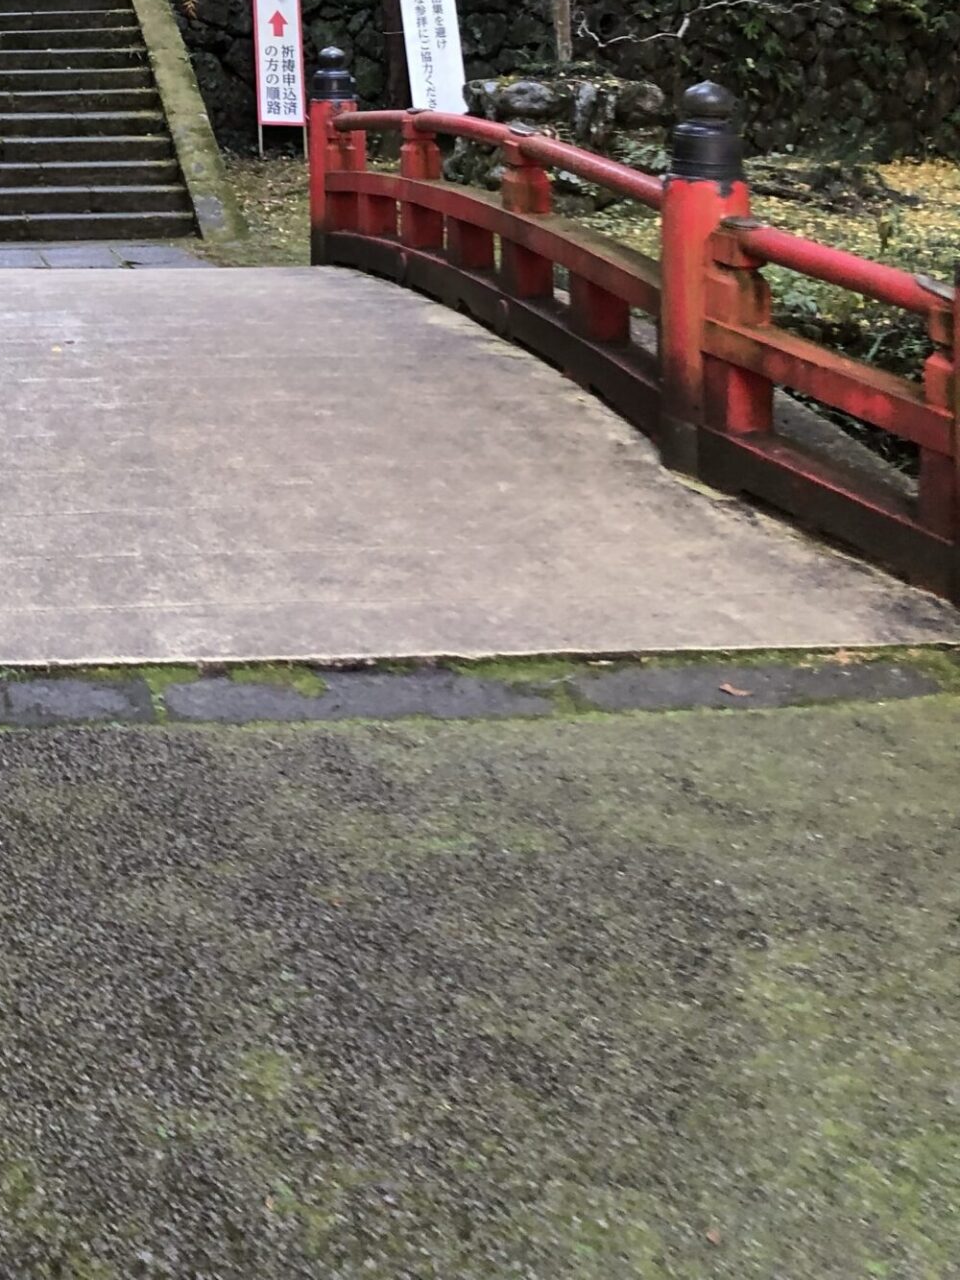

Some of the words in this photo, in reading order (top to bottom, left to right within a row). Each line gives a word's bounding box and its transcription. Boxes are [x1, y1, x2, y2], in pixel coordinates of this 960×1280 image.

[264, 45, 281, 115] の方の順路
